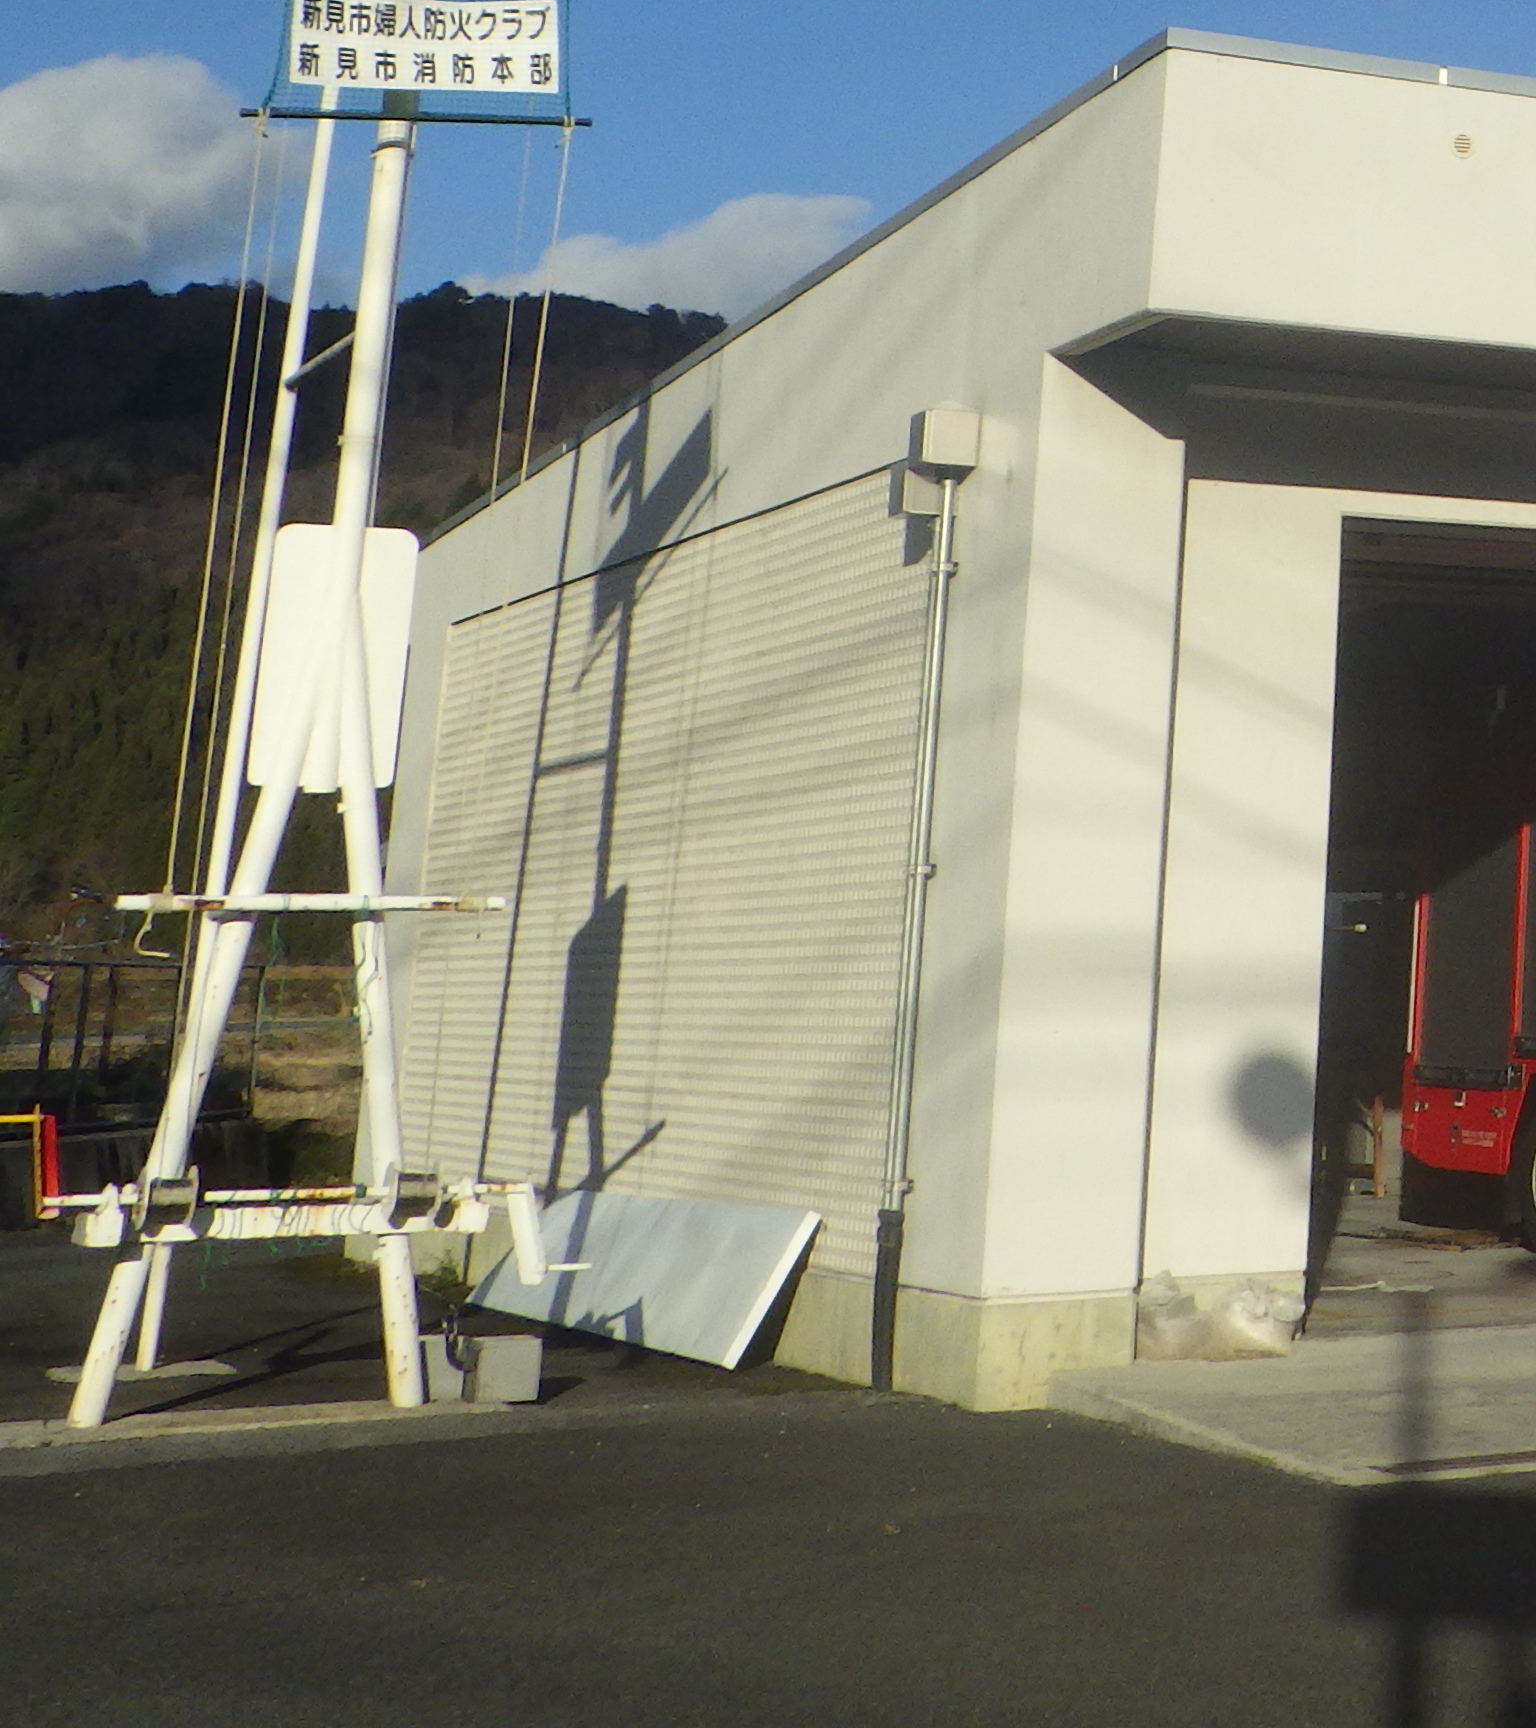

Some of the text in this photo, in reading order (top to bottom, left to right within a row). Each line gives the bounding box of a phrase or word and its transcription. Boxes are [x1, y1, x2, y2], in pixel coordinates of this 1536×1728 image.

[298, 43, 552, 86] 新見市消防本部
